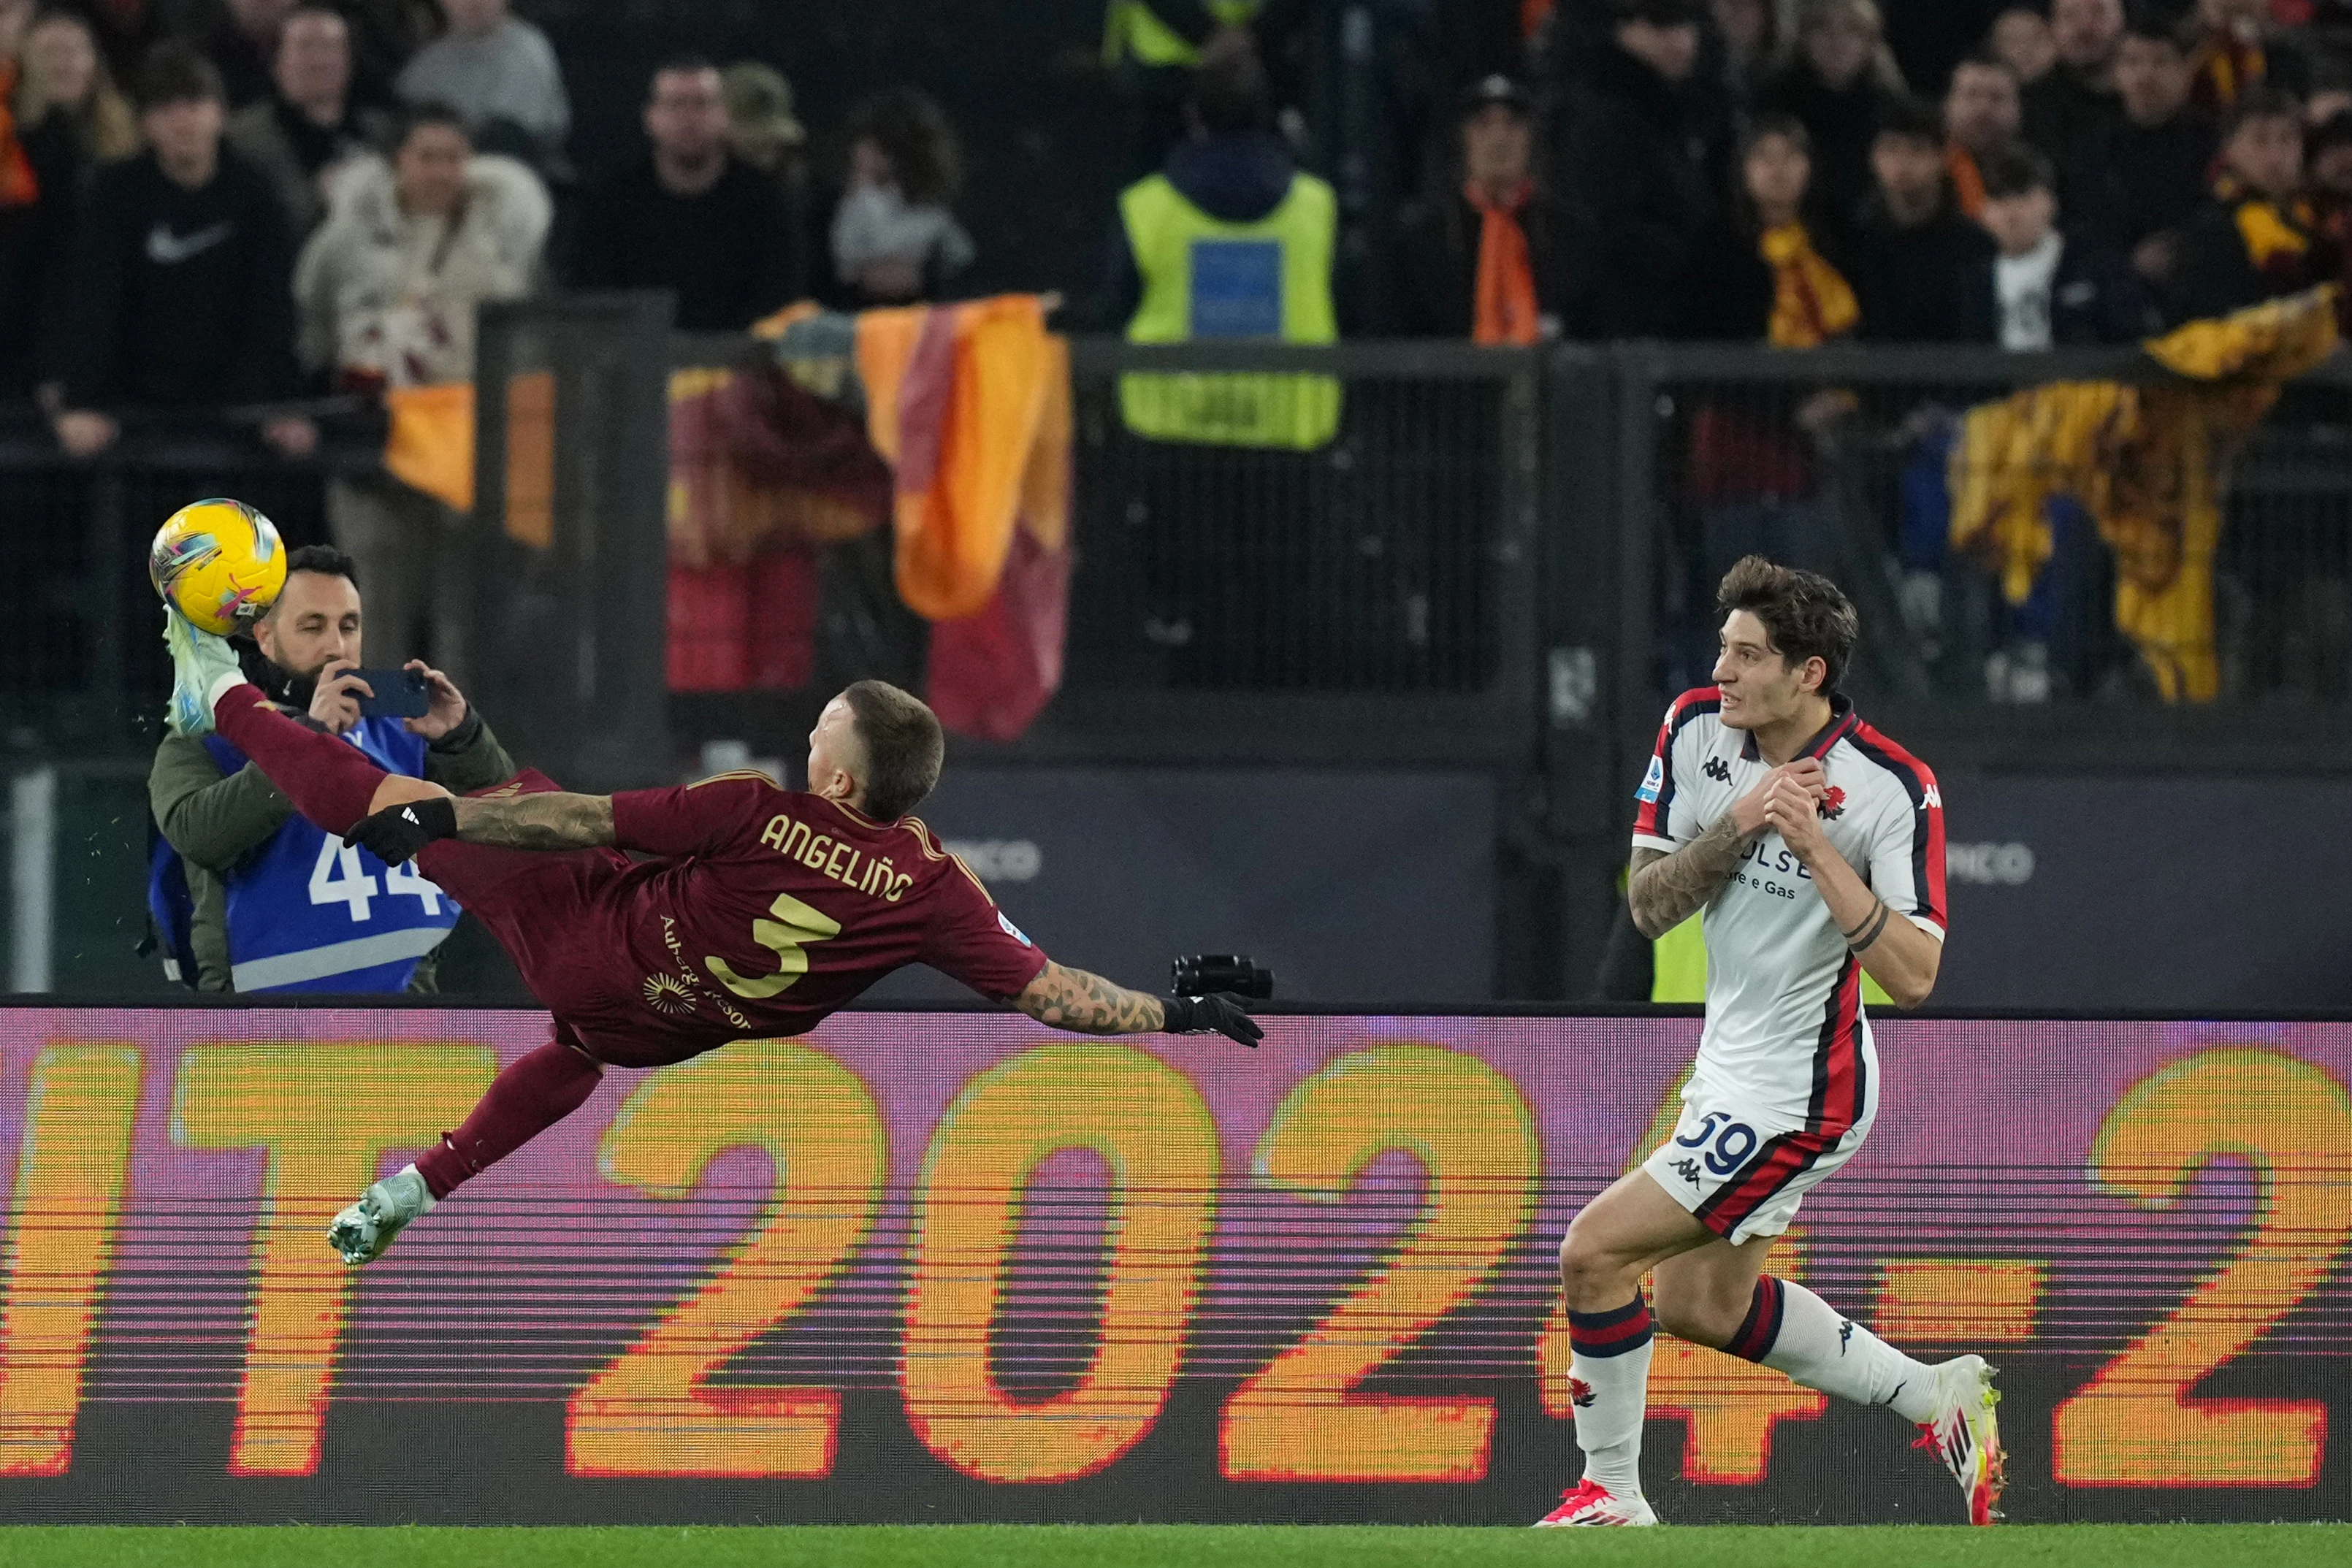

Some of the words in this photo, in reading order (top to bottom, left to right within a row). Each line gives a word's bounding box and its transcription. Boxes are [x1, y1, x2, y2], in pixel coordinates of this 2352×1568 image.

[309, 832, 444, 922] 44
[760, 814, 913, 902] ANGELIÑO
[1752, 878, 1760, 889] e
[1765, 881, 1795, 900] Gas
[660, 914, 700, 986] Auberg
[705, 892, 841, 998] 3
[1676, 1111, 1757, 1176] 59
